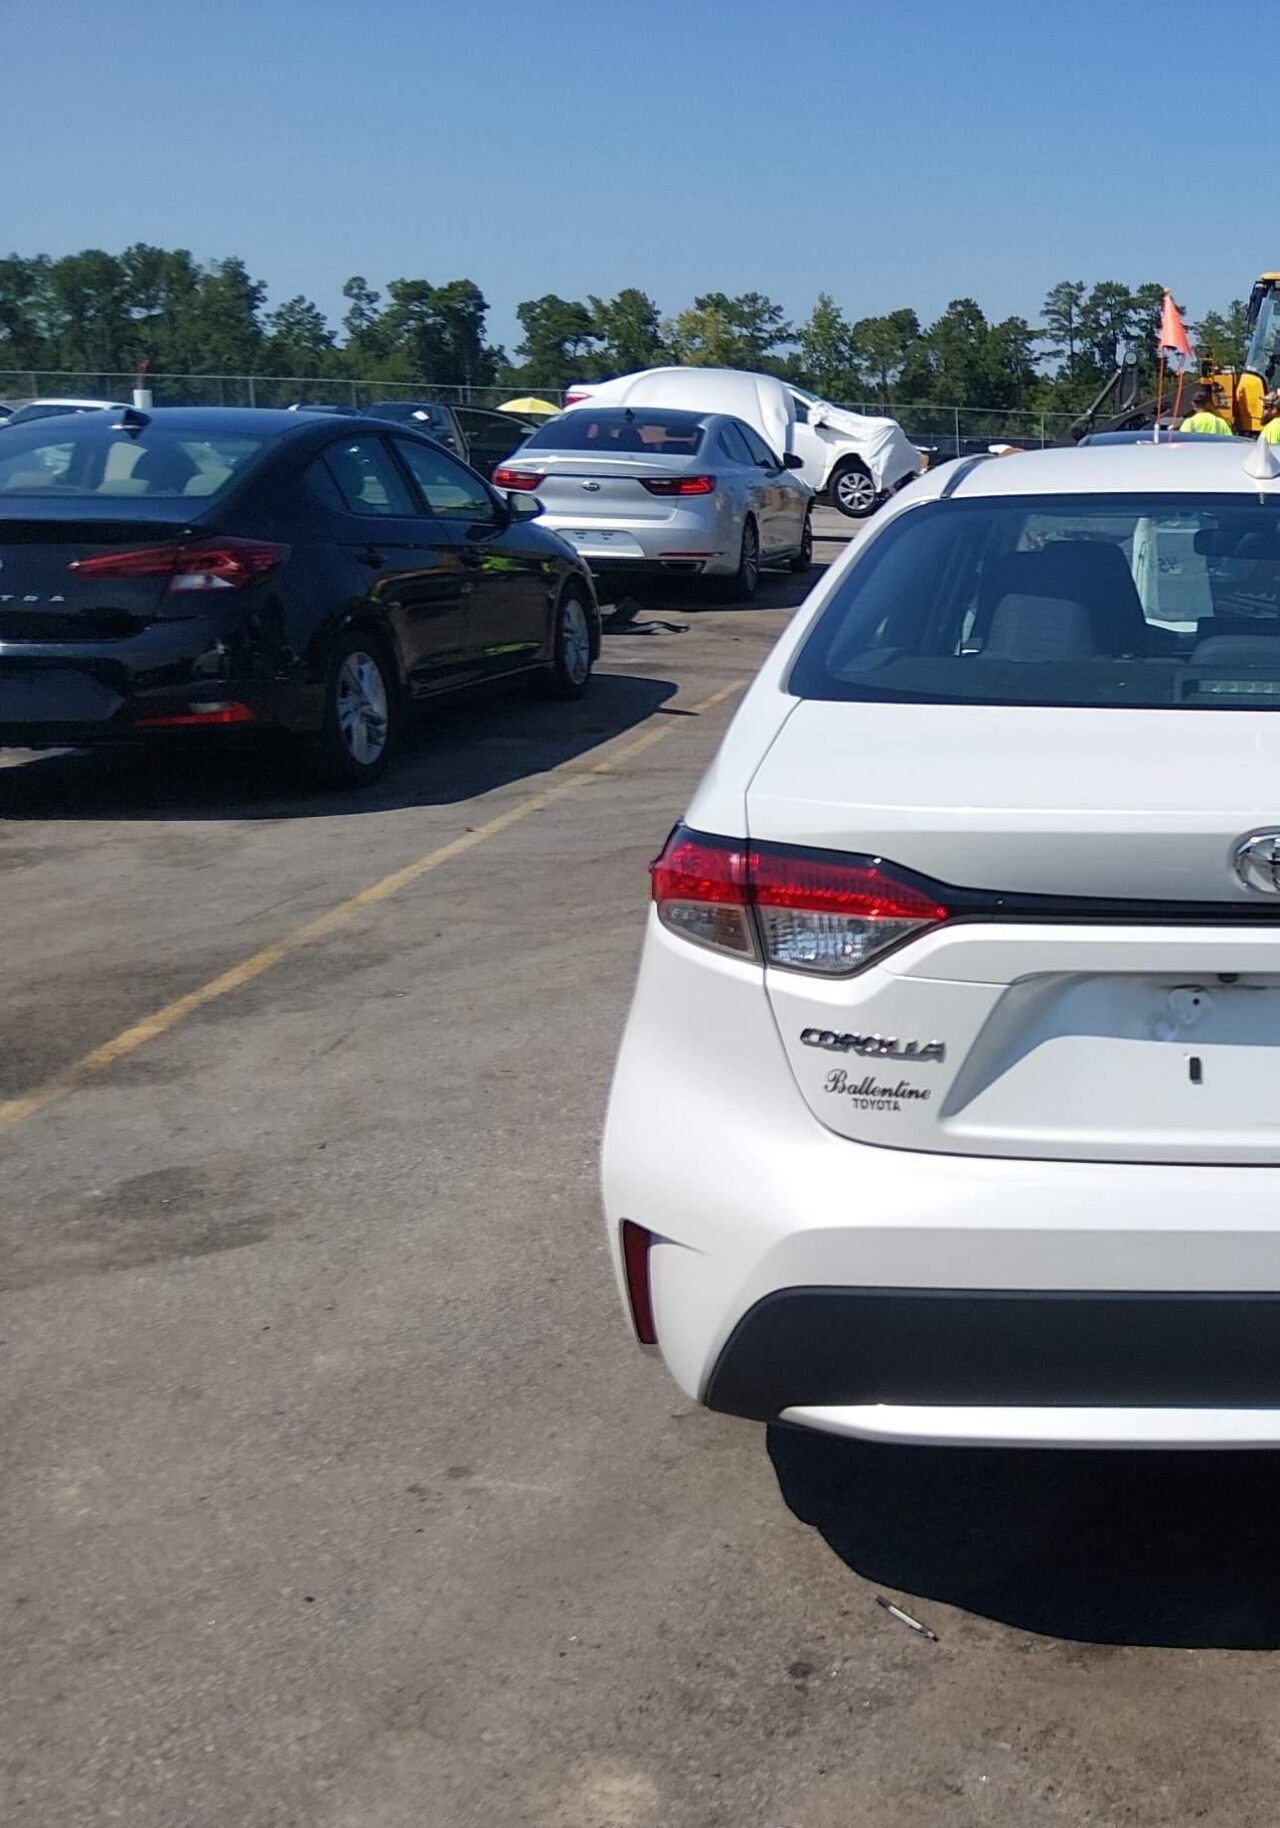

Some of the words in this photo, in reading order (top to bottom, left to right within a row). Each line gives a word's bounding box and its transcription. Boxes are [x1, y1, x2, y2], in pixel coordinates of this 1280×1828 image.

[800, 1028, 946, 1063] COROLLA
[823, 1068, 932, 1100] Ballentine
[852, 1097, 901, 1111] TOYOTA
